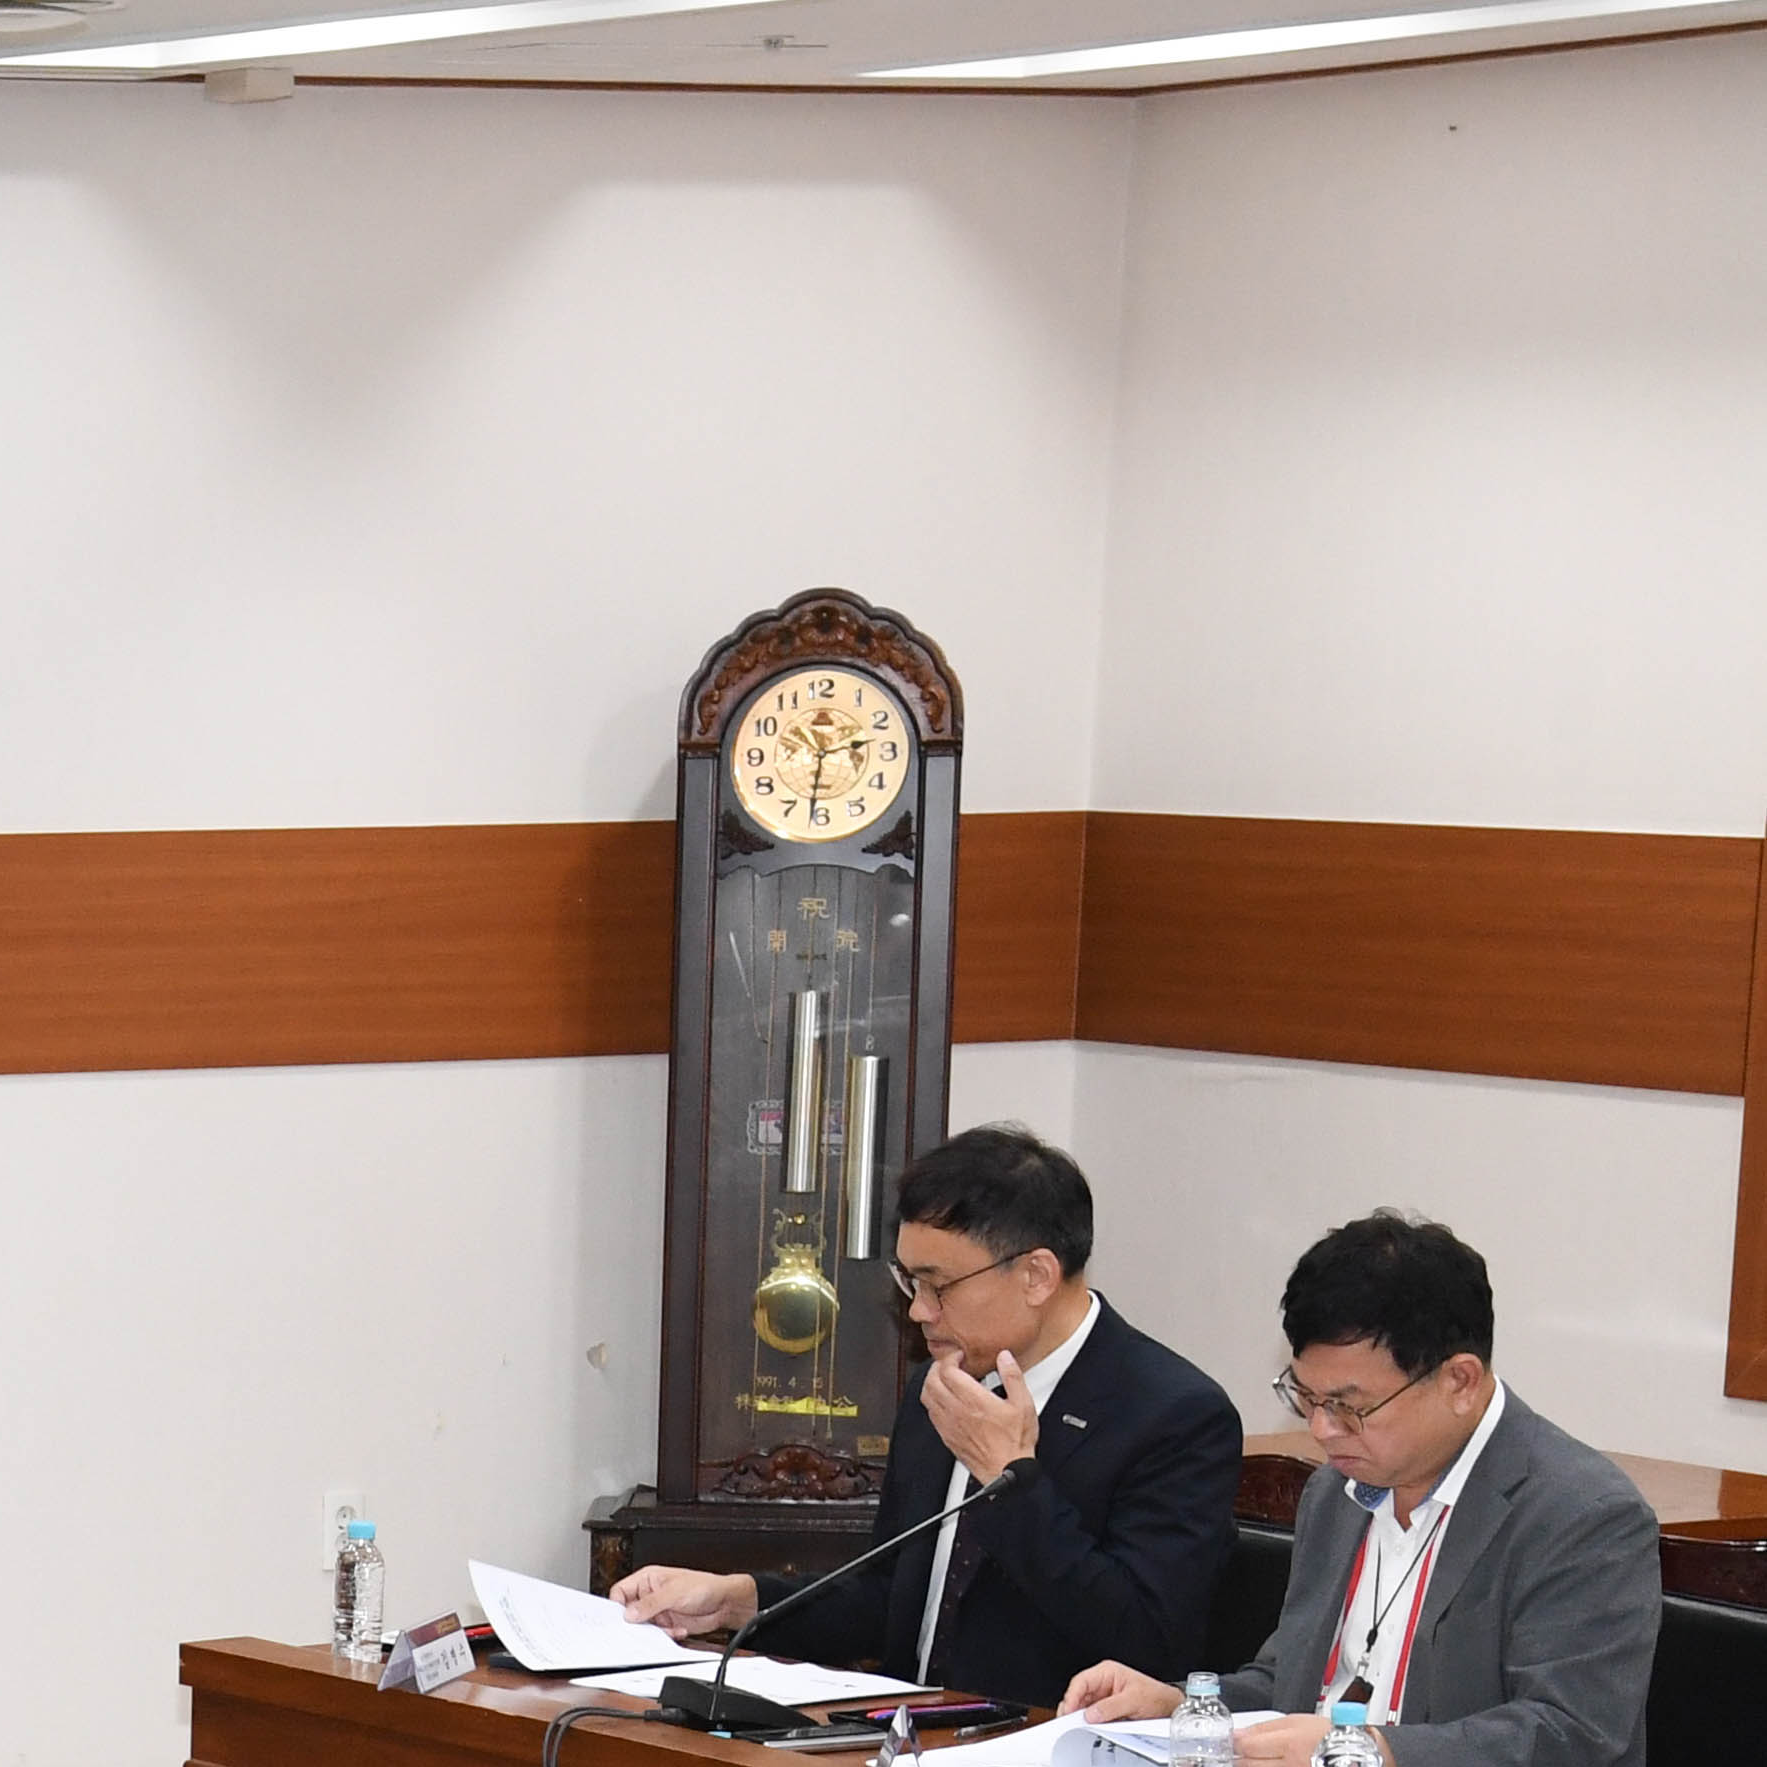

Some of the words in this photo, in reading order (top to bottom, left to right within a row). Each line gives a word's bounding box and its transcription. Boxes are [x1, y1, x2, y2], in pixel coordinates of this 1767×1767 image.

[808, 678, 835, 700] 12
[854, 688, 862, 707] 1
[777, 690, 798, 711] 11
[754, 716, 778, 737] 10
[872, 710, 890, 730] 2
[747, 747, 765, 766] 9
[879, 741, 898, 761] 3
[755, 776, 774, 795] 8
[868, 772, 887, 790] 4
[779, 798, 798, 817] 7
[846, 796, 866, 817] 5
